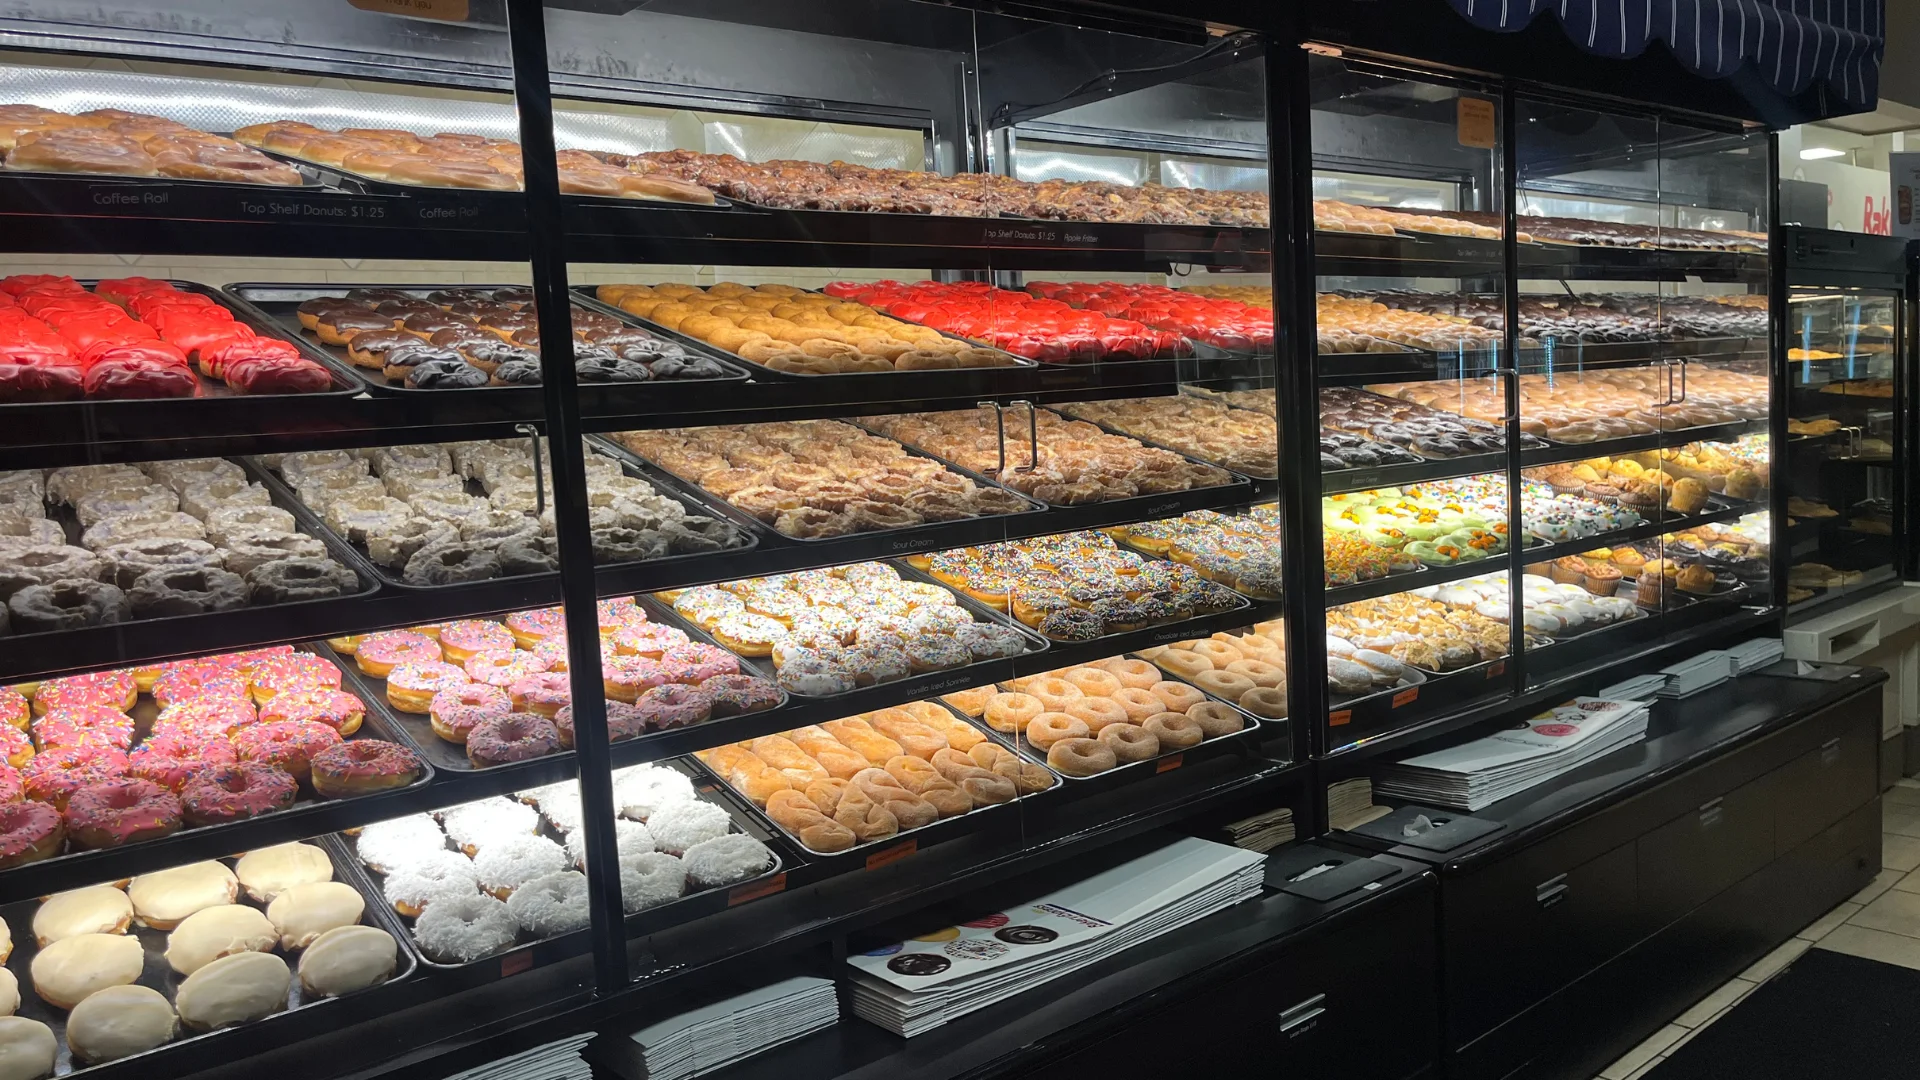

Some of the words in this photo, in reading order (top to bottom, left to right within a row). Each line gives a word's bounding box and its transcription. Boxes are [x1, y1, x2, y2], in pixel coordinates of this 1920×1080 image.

[93, 193, 139, 205] Coffee
[144, 192, 169, 204] Roll
[241, 202, 266, 215] Top
[269, 203, 300, 215] Shelf
[304, 204, 347, 217] Donuts:
[351, 205, 385, 218] $1.25
[419, 207, 456, 218] Coffee
[459, 206, 479, 218] Roll
[997, 229, 1014, 238] Shelf
[1038, 231, 1056, 241] $1.25
[1064, 233, 1081, 243] Apple
[1082, 234, 1099, 243] Fritter
[1148, 506, 1160, 515] Sour
[1161, 502, 1180, 511] Cream
[892, 541, 908, 550] Sour
[909, 539, 934, 548] Cream
[906, 685, 928, 696] Vanilla
[930, 681, 944, 690] Iced
[946, 676, 971, 687] Sprinkle
